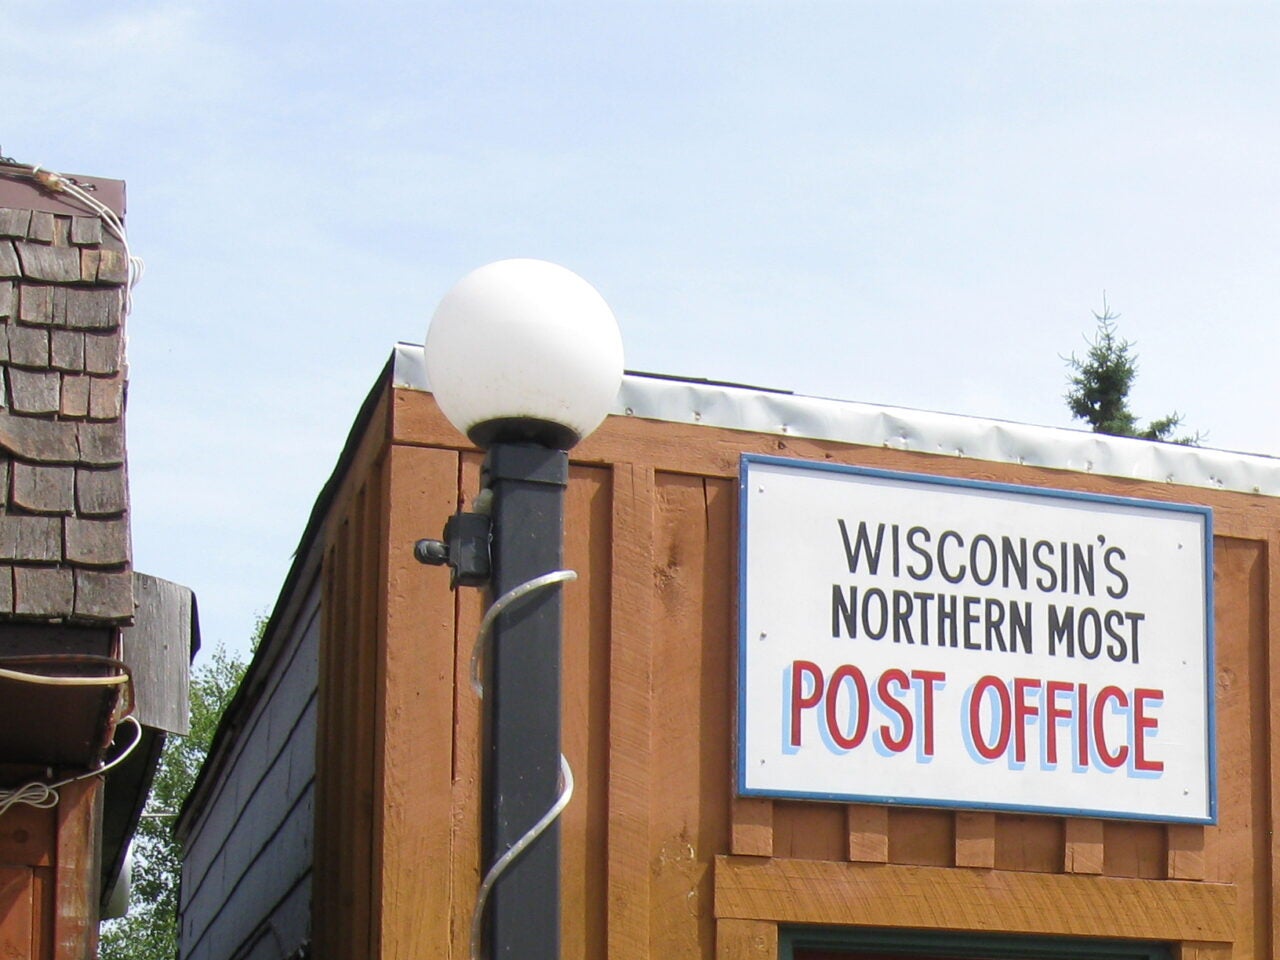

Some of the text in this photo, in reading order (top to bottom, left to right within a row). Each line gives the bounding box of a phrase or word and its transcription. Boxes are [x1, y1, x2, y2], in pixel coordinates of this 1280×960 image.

[837, 518, 1130, 600] WISCONSIN'S
[831, 584, 1146, 664] NORTHERN MOST
[782, 660, 1165, 779] POST OFFICE
